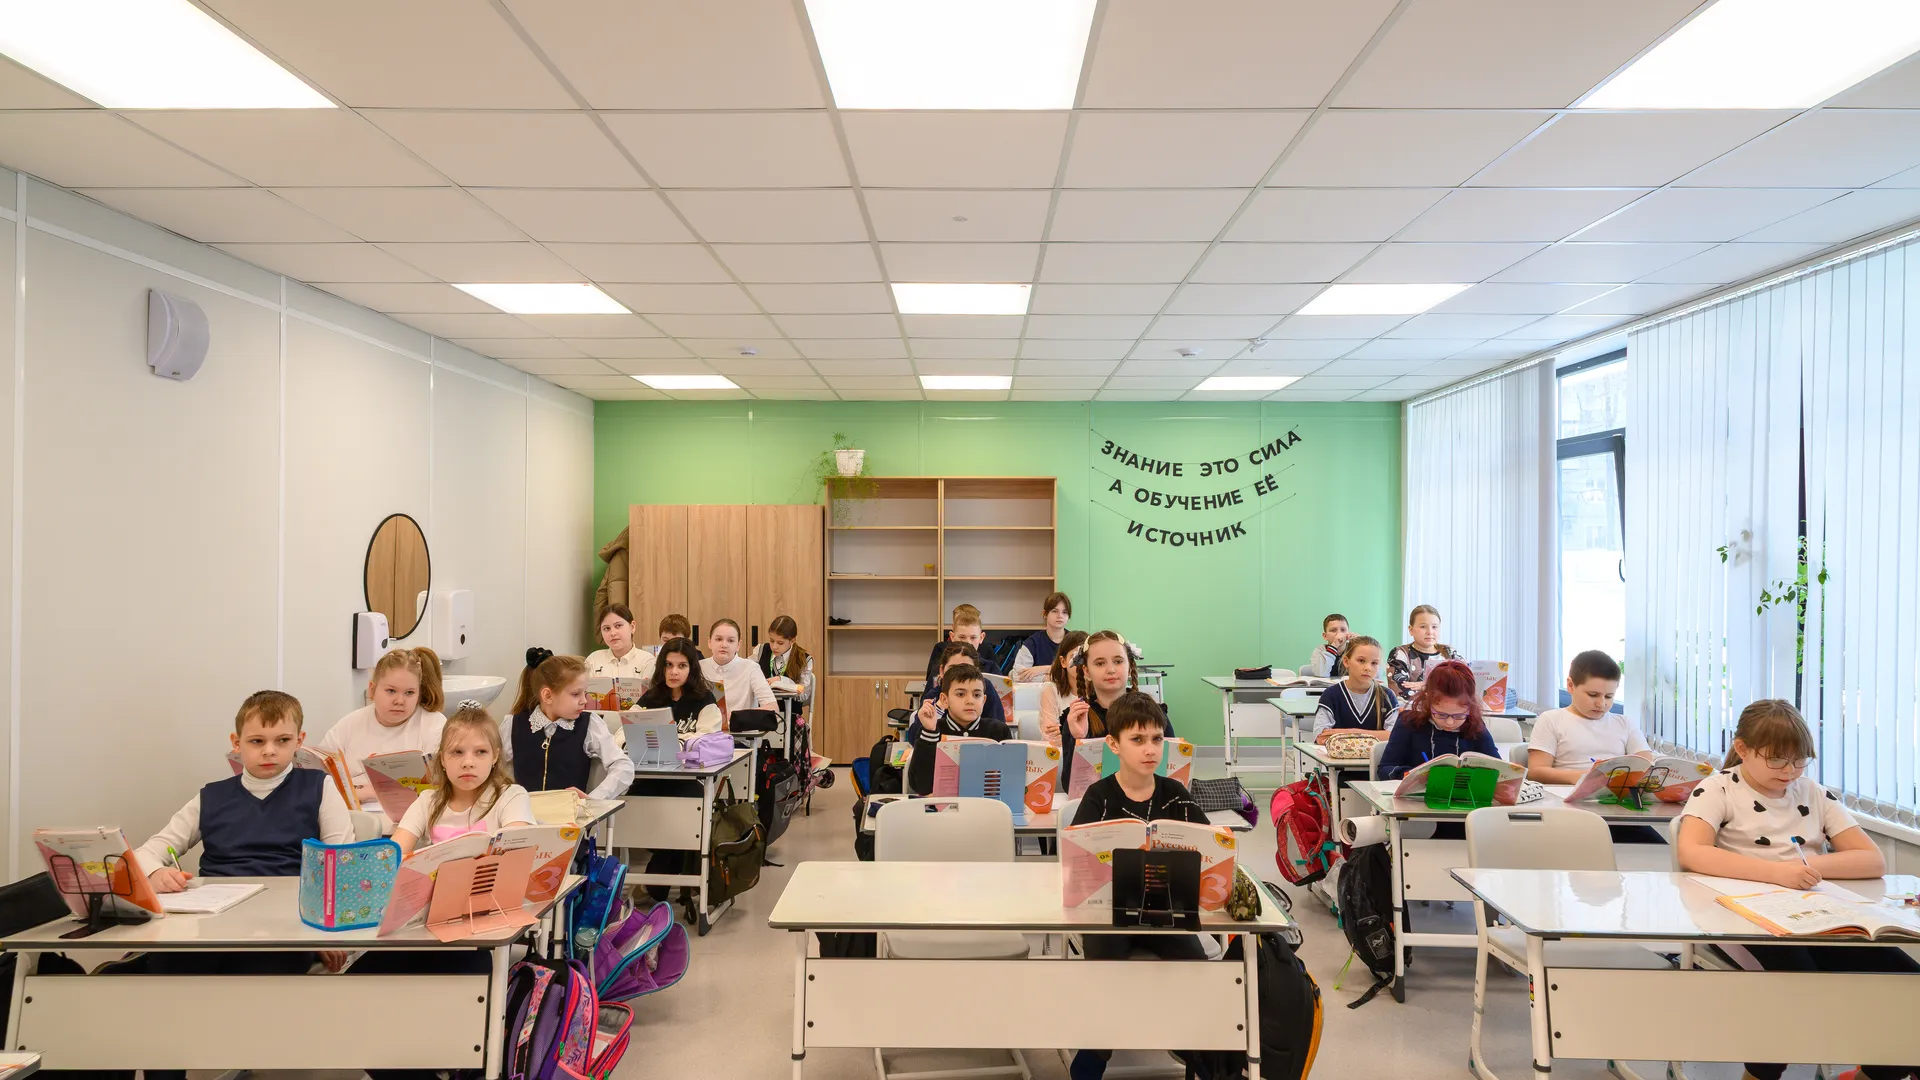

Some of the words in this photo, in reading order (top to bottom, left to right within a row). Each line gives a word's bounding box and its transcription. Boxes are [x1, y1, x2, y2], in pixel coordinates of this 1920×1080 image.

[1101, 440, 1183, 477] ЗНАНИЕ
[1200, 458, 1239, 477] ЭТО
[1249, 430, 1302, 466] СИЛА
[1108, 479, 1123, 494] А
[1134, 488, 1244, 511] ОБУЧЕНИЕ
[1254, 473, 1279, 496] ЕЁ
[1127, 520, 1247, 547] ИСТОЧНИК
[1031, 781, 1052, 807] 3
[1152, 839, 1198, 852] Русский
[528, 866, 563, 895] 3
[1200, 873, 1229, 904] 3
